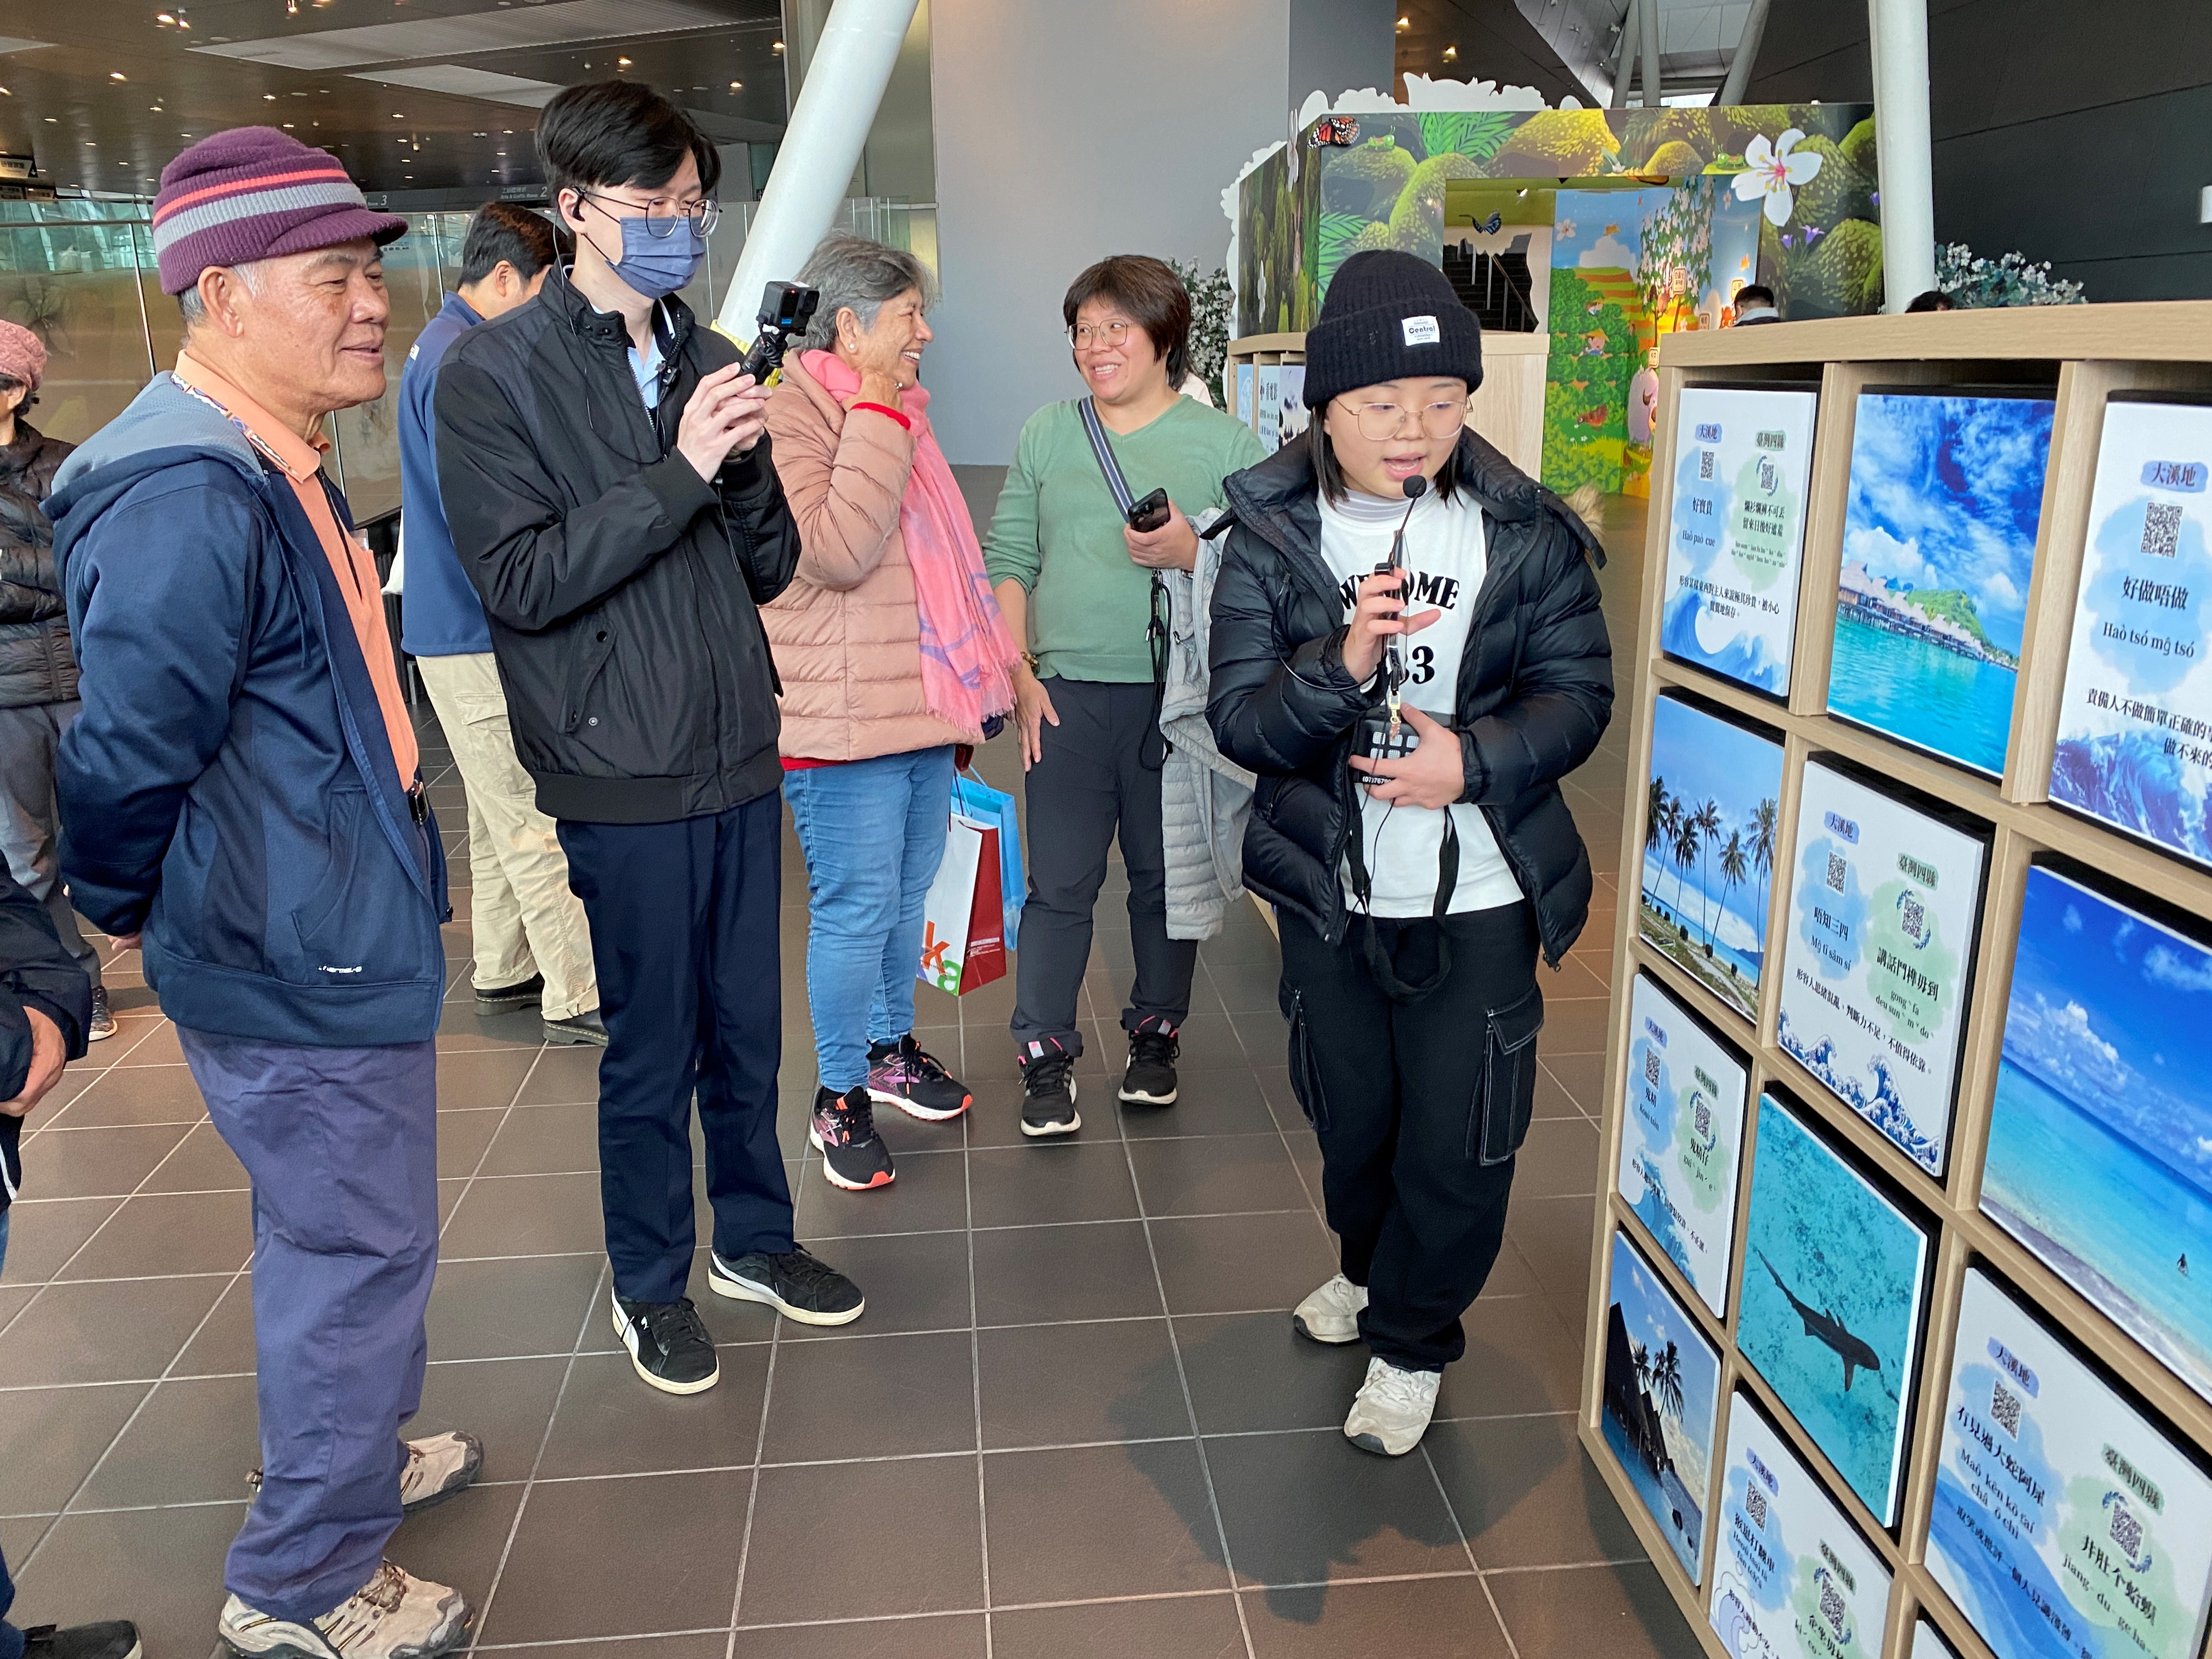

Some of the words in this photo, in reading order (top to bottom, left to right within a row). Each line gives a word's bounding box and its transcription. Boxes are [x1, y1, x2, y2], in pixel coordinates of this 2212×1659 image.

[1699, 425, 1718, 439] 大溪地
[1757, 432, 1784, 449] 臺灣四縣
[2152, 461, 2196, 487] 大溪地
[1692, 497, 1712, 516] 好寶貴
[2121, 575, 2189, 611] 好做唔做
[2130, 629, 2148, 646] tsó
[2175, 641, 2194, 658] tsó
[1830, 814, 1853, 839] 大溪地
[1899, 853, 1936, 887] 臺灣四縣
[1814, 906, 1849, 941] 唔知三四
[1995, 1345, 2030, 1387] 大溪地
[2106, 1448, 2161, 1512] 臺灣四縣
